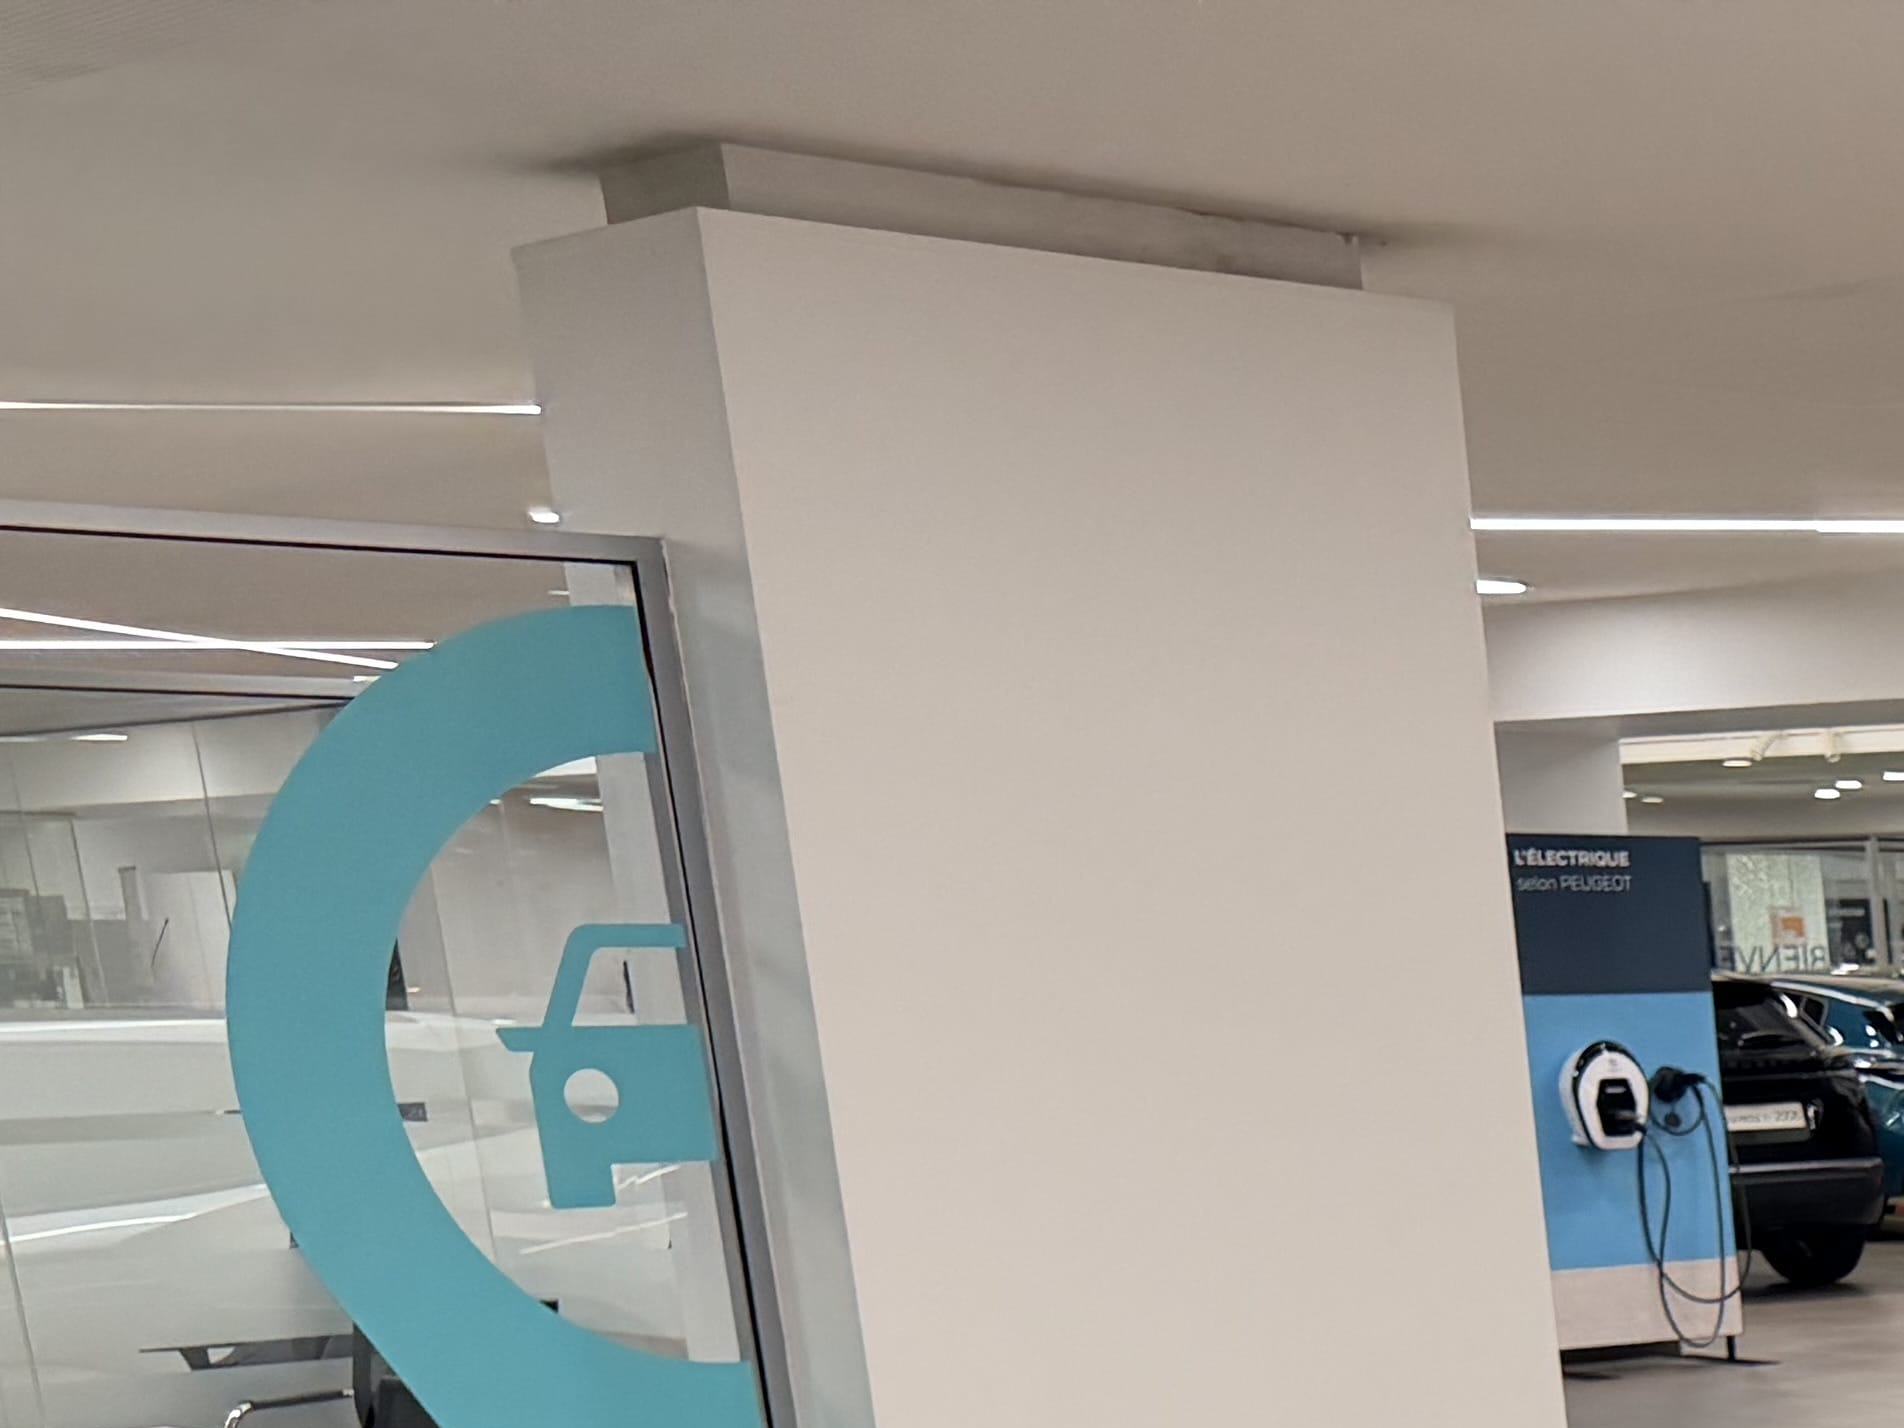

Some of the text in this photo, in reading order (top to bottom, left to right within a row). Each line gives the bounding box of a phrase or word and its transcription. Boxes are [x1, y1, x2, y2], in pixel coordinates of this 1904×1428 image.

[1514, 850, 1630, 867] L'ÉLECTRIQUE
[1517, 875, 1632, 891] selon PEUGEOT
